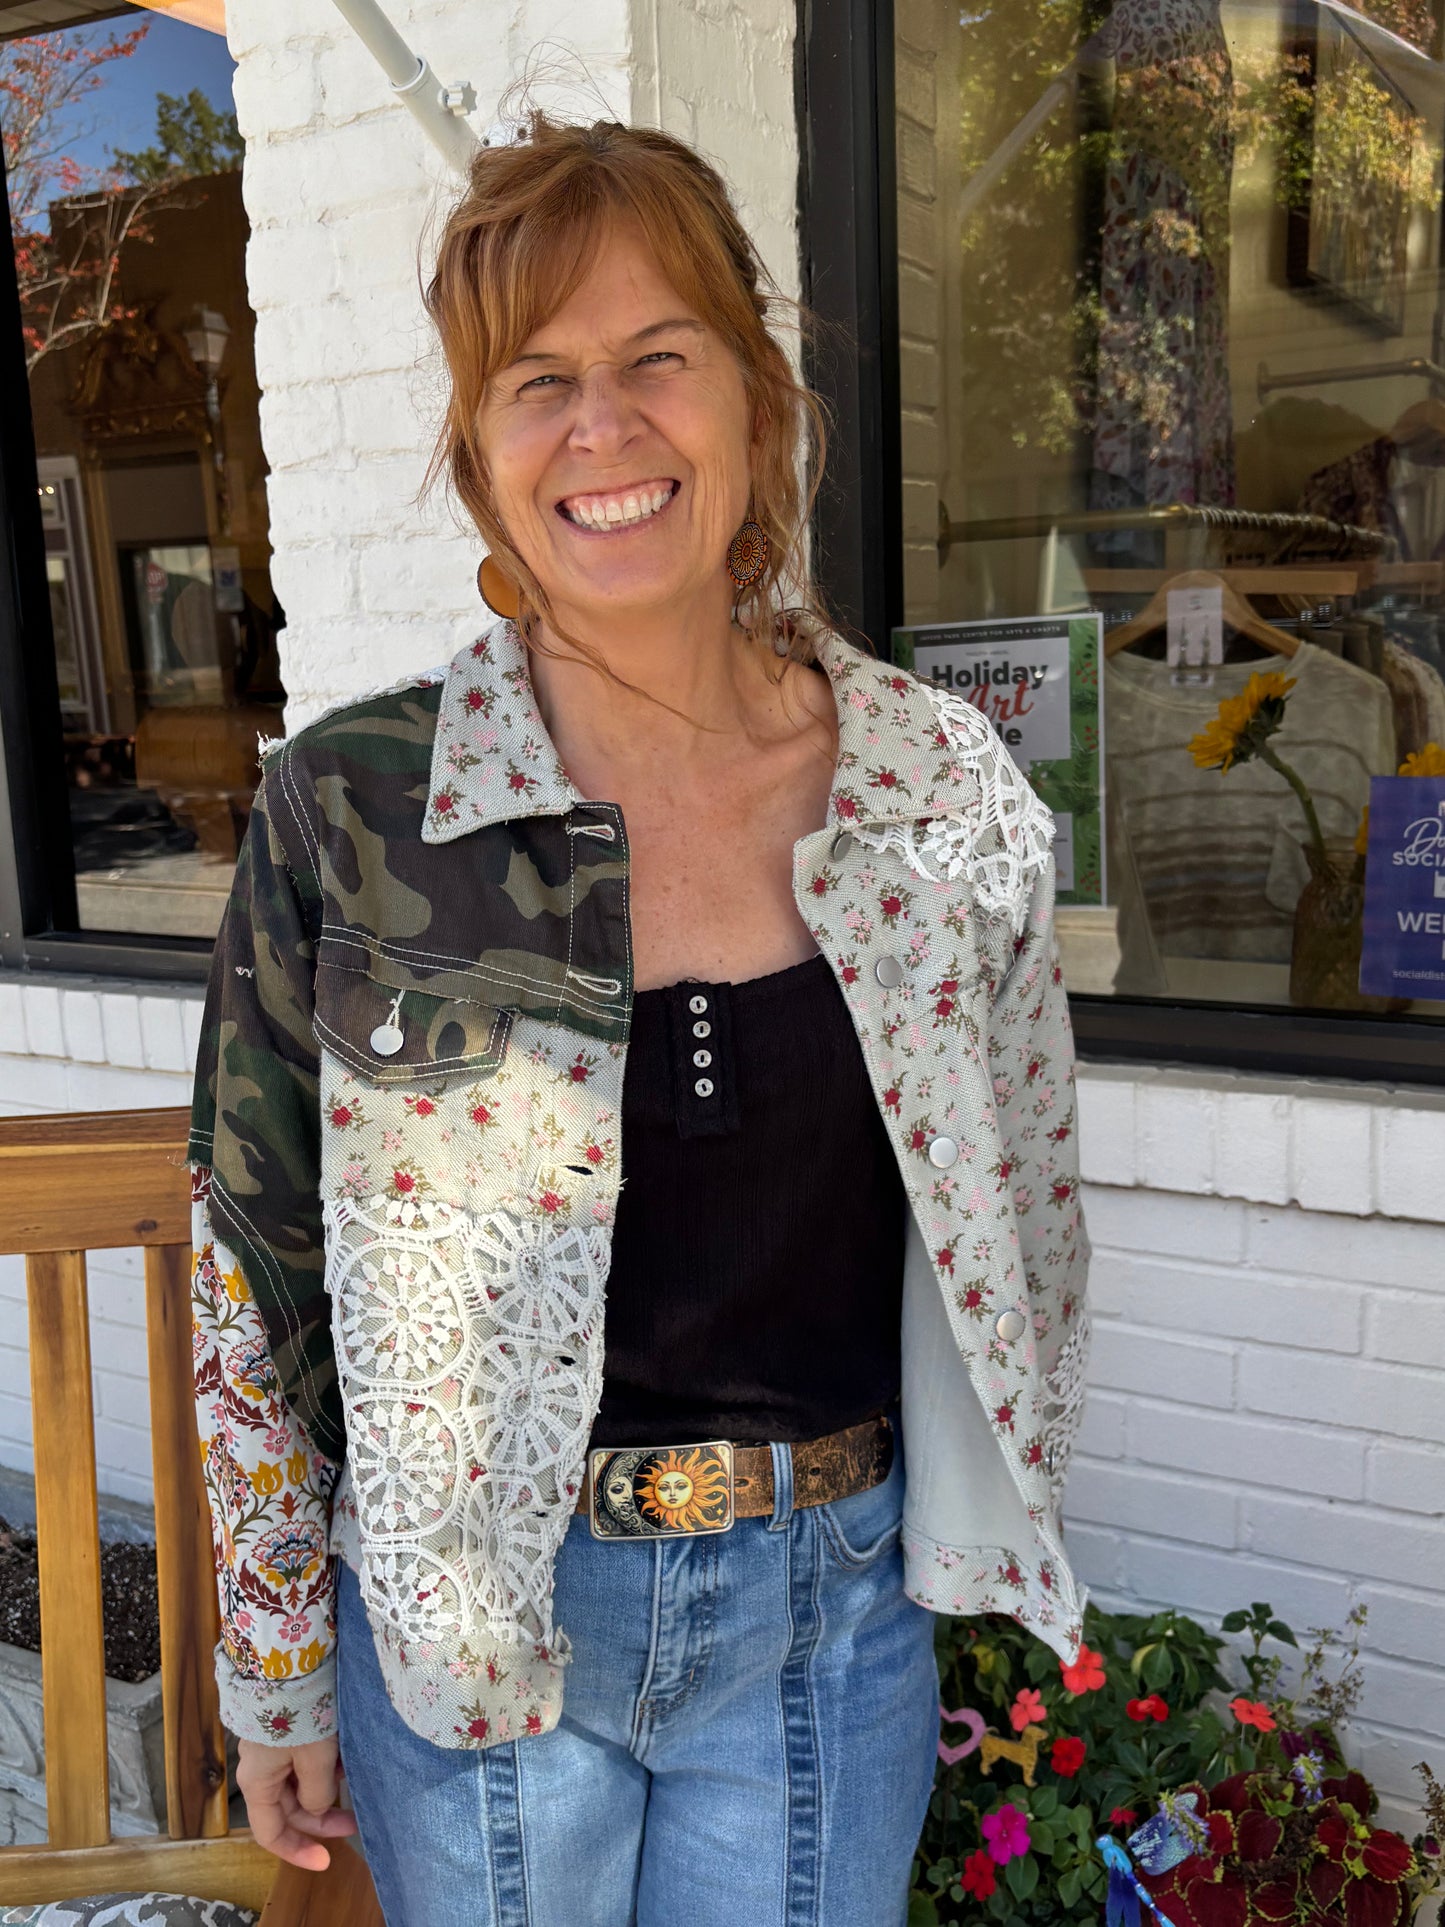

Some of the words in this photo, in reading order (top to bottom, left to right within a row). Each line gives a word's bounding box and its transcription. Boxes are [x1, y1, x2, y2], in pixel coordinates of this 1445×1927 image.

[932, 660, 1048, 690] Holiday
[966, 680, 1034, 721] Art
[995, 723, 1022, 746] le
[1397, 911, 1445, 934] WE
